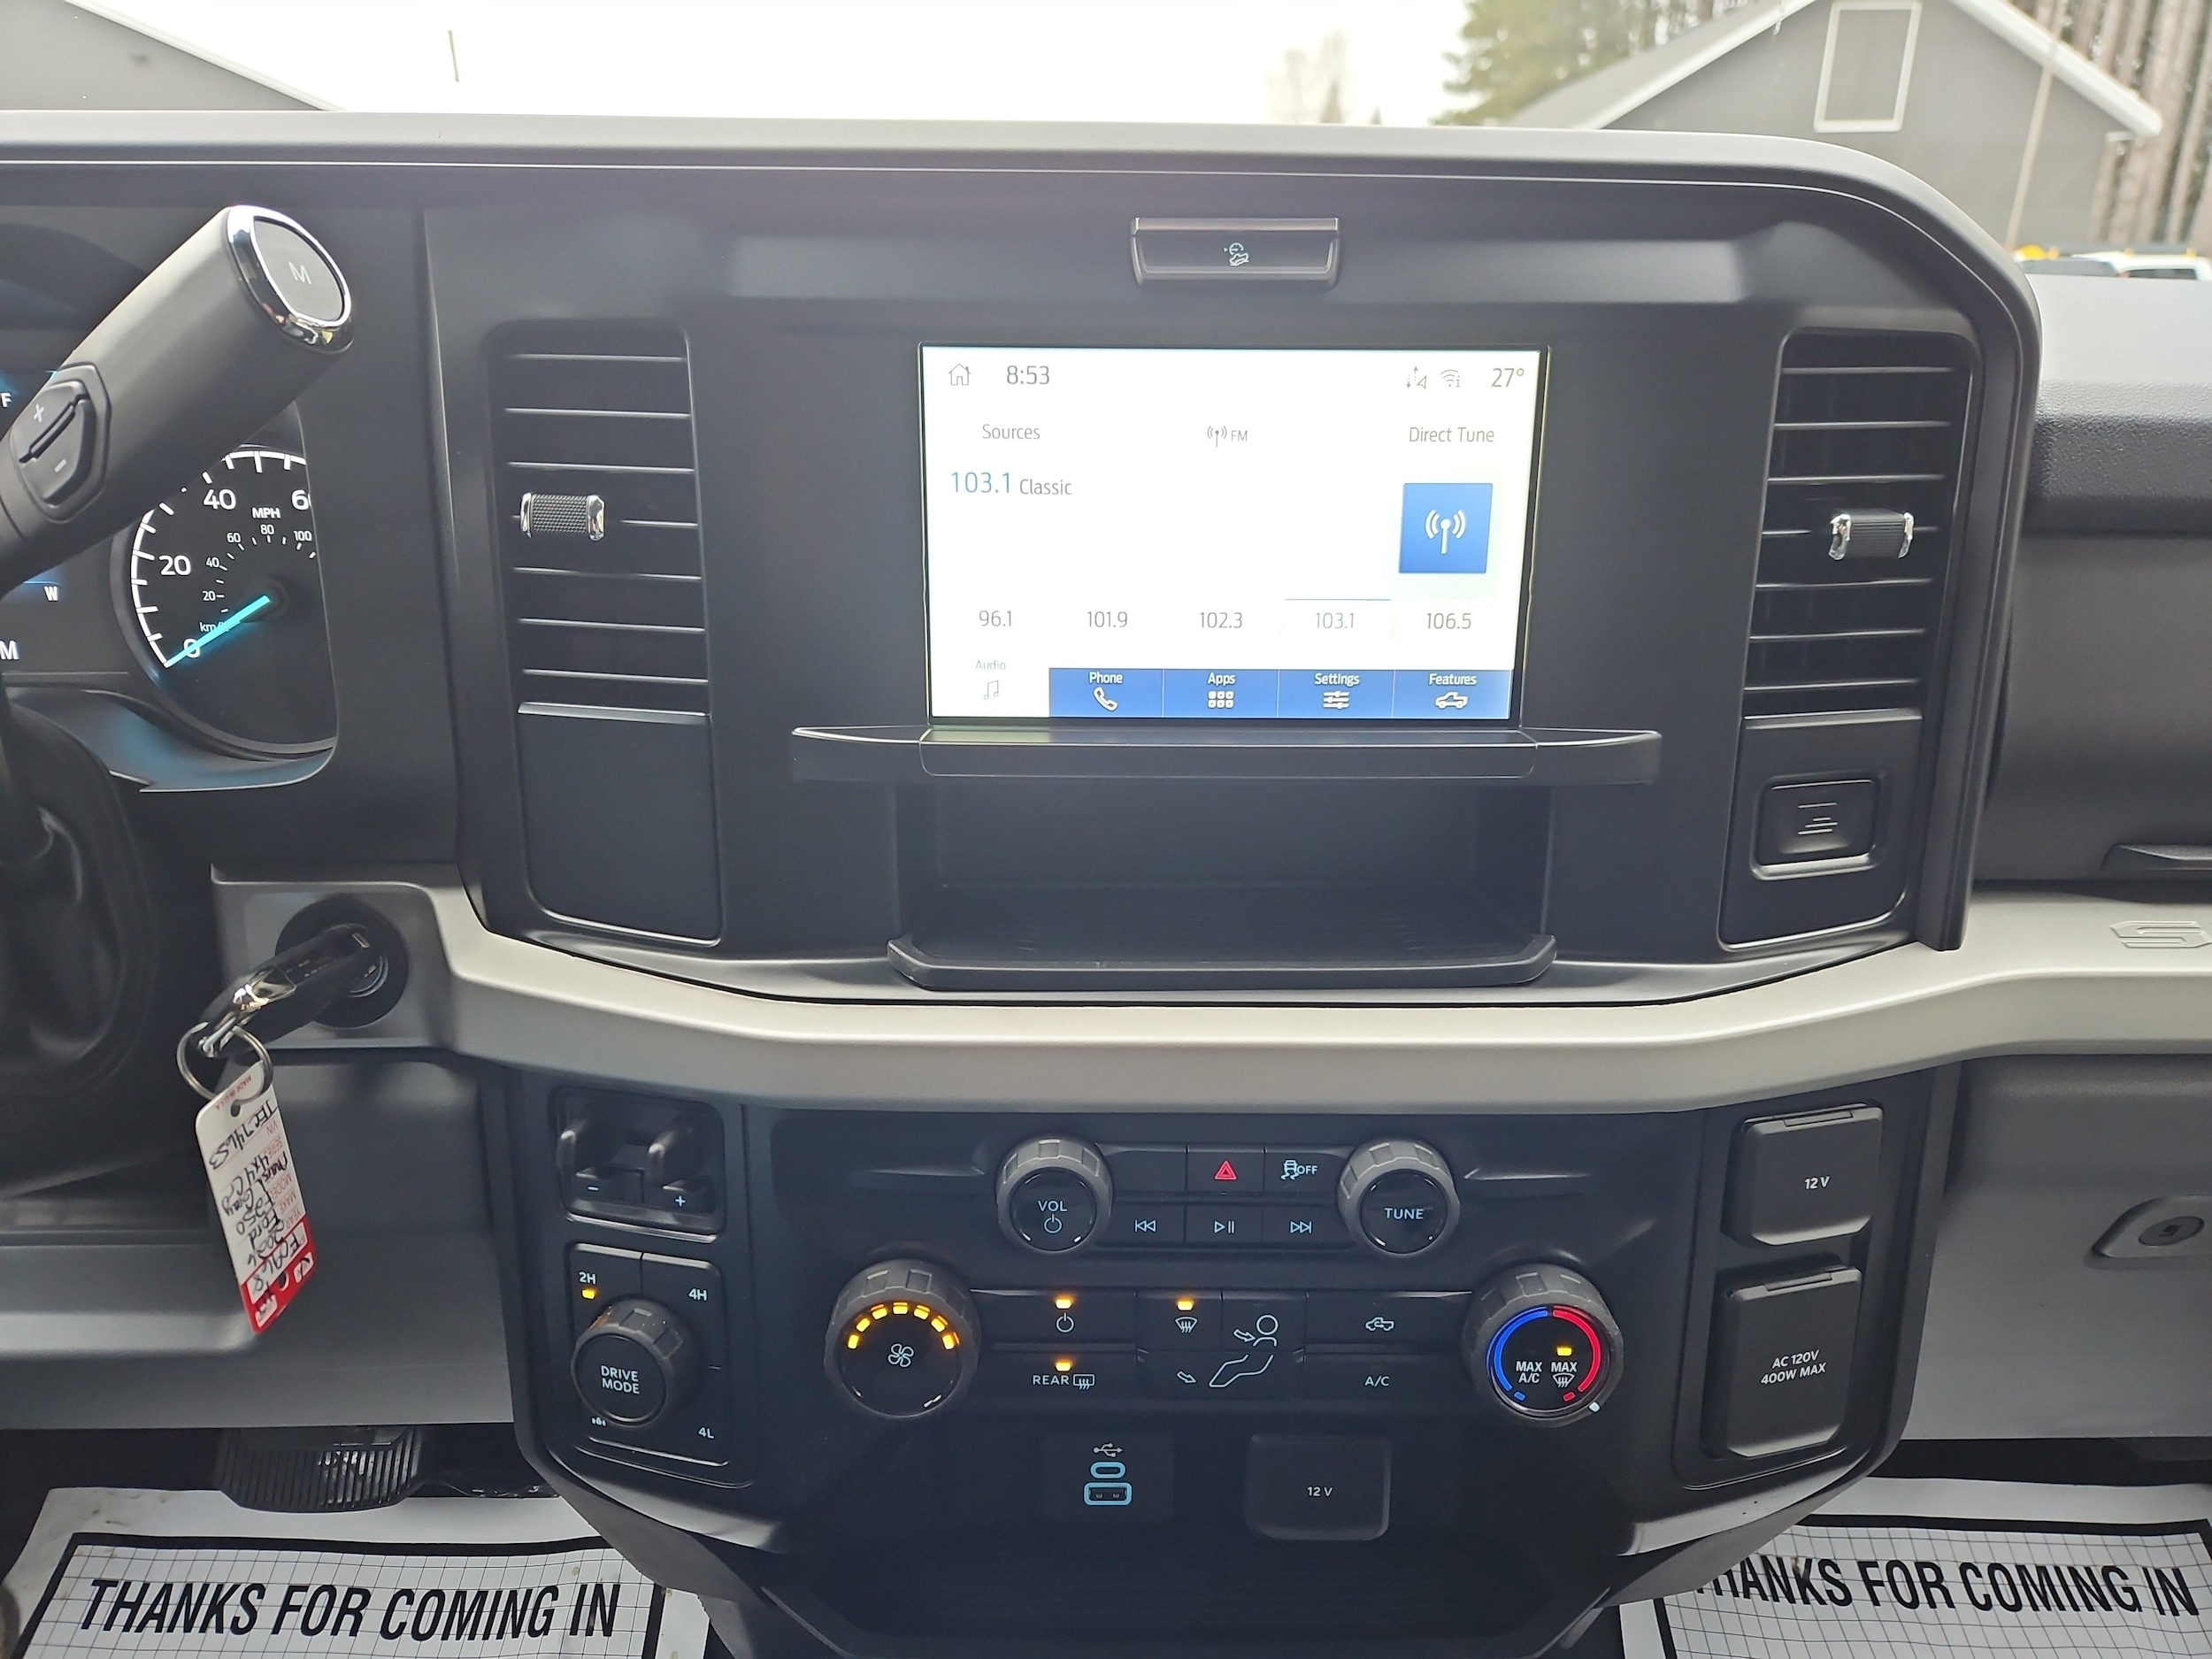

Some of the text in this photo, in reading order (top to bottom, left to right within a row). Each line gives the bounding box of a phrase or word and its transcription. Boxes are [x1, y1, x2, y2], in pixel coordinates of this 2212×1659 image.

[288, 261, 312, 285] M
[1006, 365, 1050, 385] 8:53
[1491, 367, 1525, 388] 27°
[0, 392, 12, 408] F
[982, 424, 1041, 440] Sources
[1231, 430, 1249, 442] FM
[1409, 426, 1494, 442] Direct Tune
[951, 472, 1071, 495] 103.1 Classic
[203, 488, 236, 510] 40
[291, 489, 311, 511] 6
[252, 507, 281, 518] MPH
[260, 524, 275, 535] 80
[293, 530, 312, 541] 100
[227, 532, 242, 543] 60
[158, 555, 192, 576] 20
[205, 557, 220, 568] 40
[43, 586, 58, 601] W
[202, 590, 216, 602] 20
[979, 610, 1011, 627] 96.1
[1087, 611, 1128, 628] 101.9
[1200, 611, 1242, 629] 102.3
[1316, 612, 1355, 629] 103.1
[1426, 612, 1471, 630] 106.5
[975, 659, 1007, 670] Audio
[1089, 671, 1123, 684] Phone
[1207, 672, 1236, 687] Apps
[1314, 672, 1360, 687] Settings
[1429, 672, 1477, 685] Features
[1298, 1164, 1318, 1175] OFF
[1804, 1176, 1830, 1190] 12 V
[1038, 1200, 1068, 1212] VOL
[1384, 1207, 1425, 1220] TUNE
[579, 1271, 596, 1285] 2H
[688, 1288, 707, 1302] 4H
[1771, 1349, 1820, 1369] AC 120V
[601, 1366, 639, 1381] DRIVE
[1517, 1362, 1542, 1374] MAX
[1552, 1362, 1577, 1374] MAX
[1760, 1361, 1827, 1385] 400W MAX
[1033, 1374, 1070, 1386] REAR
[1364, 1375, 1390, 1387] A/C
[1519, 1372, 1540, 1383] A/C
[602, 1377, 640, 1394] MODE
[698, 1427, 715, 1440] 4L
[1307, 1486, 1333, 1497] 12 V
[1855, 1559, 1956, 1611] FOR
[1957, 1561, 2143, 1614] COMING
[2145, 1564, 2200, 1617] IN
[78, 1577, 622, 1644] THANKS FOR COMING IN
